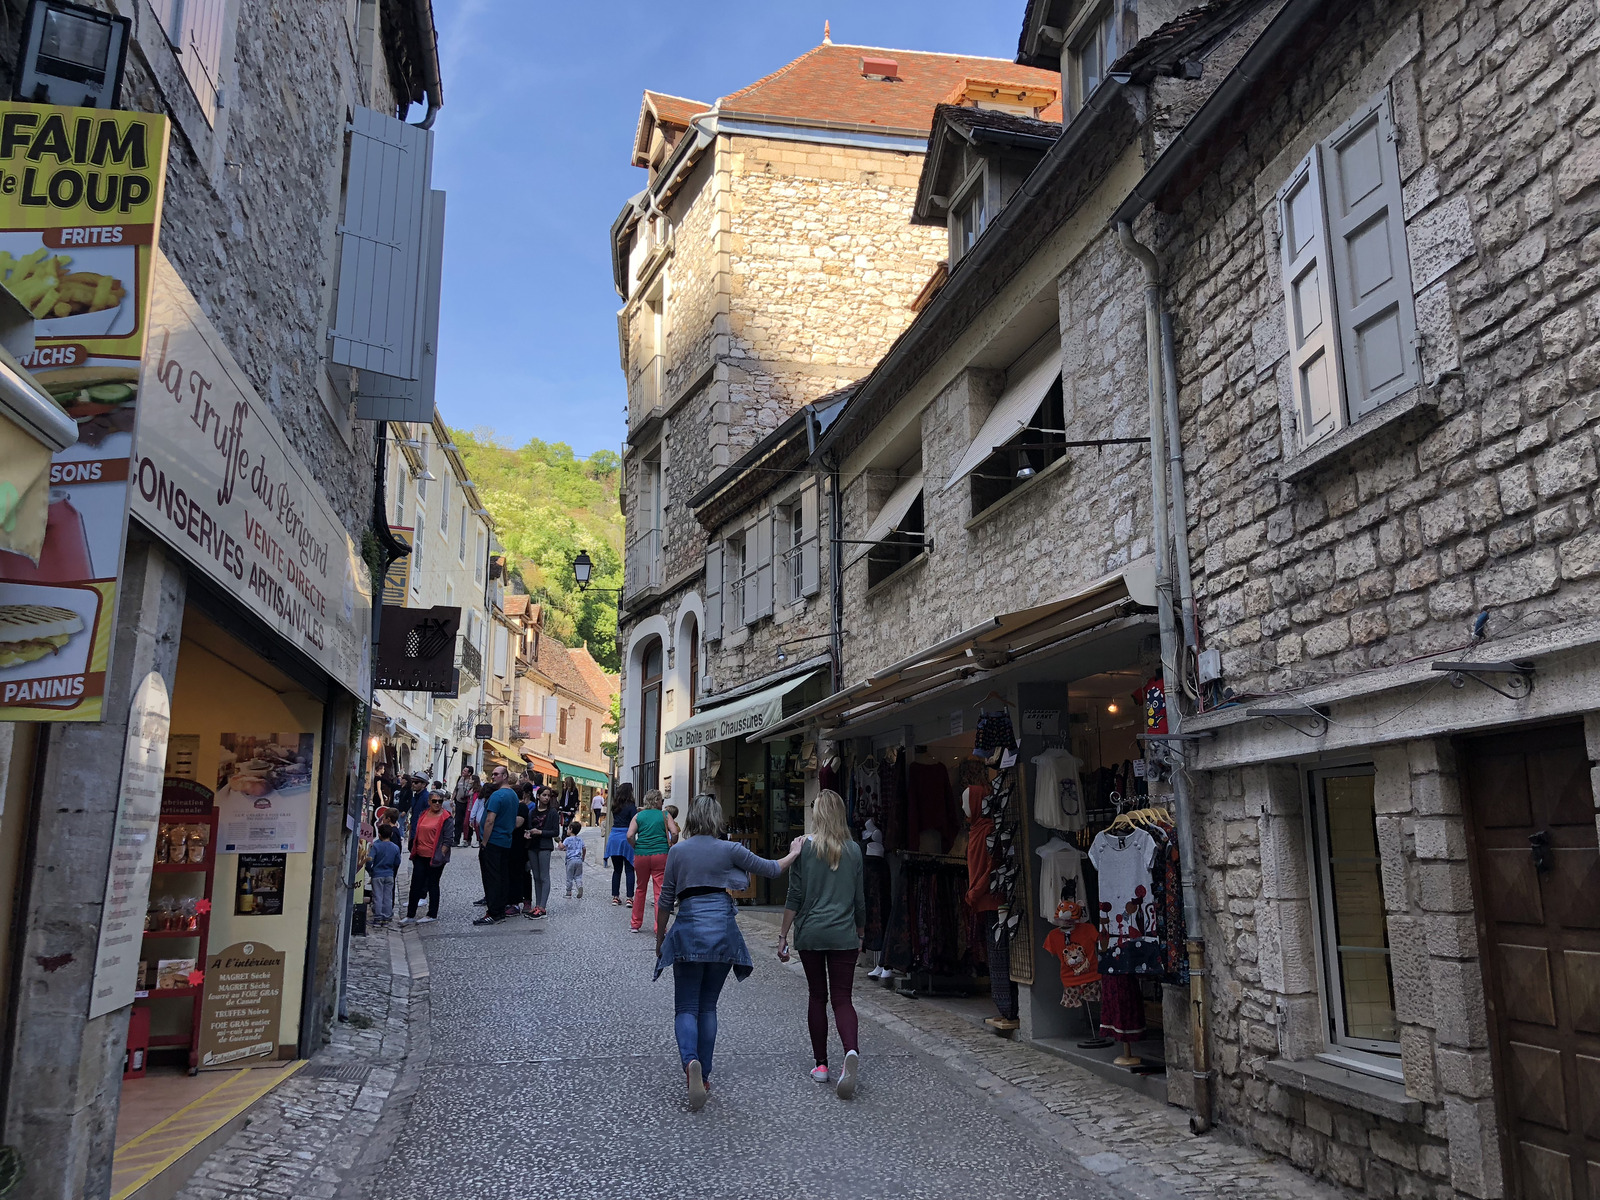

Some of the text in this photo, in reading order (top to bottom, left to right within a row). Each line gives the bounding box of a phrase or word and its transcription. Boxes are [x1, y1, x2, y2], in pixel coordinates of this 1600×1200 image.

[0, 112, 148, 169] FAIM
[19, 167, 152, 213] LOUP
[60, 226, 123, 244] FRITES
[15, 347, 77, 366] WICHS
[50, 463, 102, 483] SONS
[189, 370, 249, 506] Truffe
[251, 454, 274, 512] du
[276, 482, 328, 579] Périgord
[244, 509, 327, 618] VENTE DIRECTE
[248, 561, 325, 651] ARTISANALES
[4, 677, 85, 703] PANINIS
[675, 713, 763, 748] La Boîte aux Chaussures
[211, 958, 281, 969] A l'intérieur
[219, 973, 249, 981] MAGRET
[226, 997, 262, 1006] de Canard
[215, 1009, 246, 1017] TRUFFES
[229, 1033, 262, 1042] Guérande
